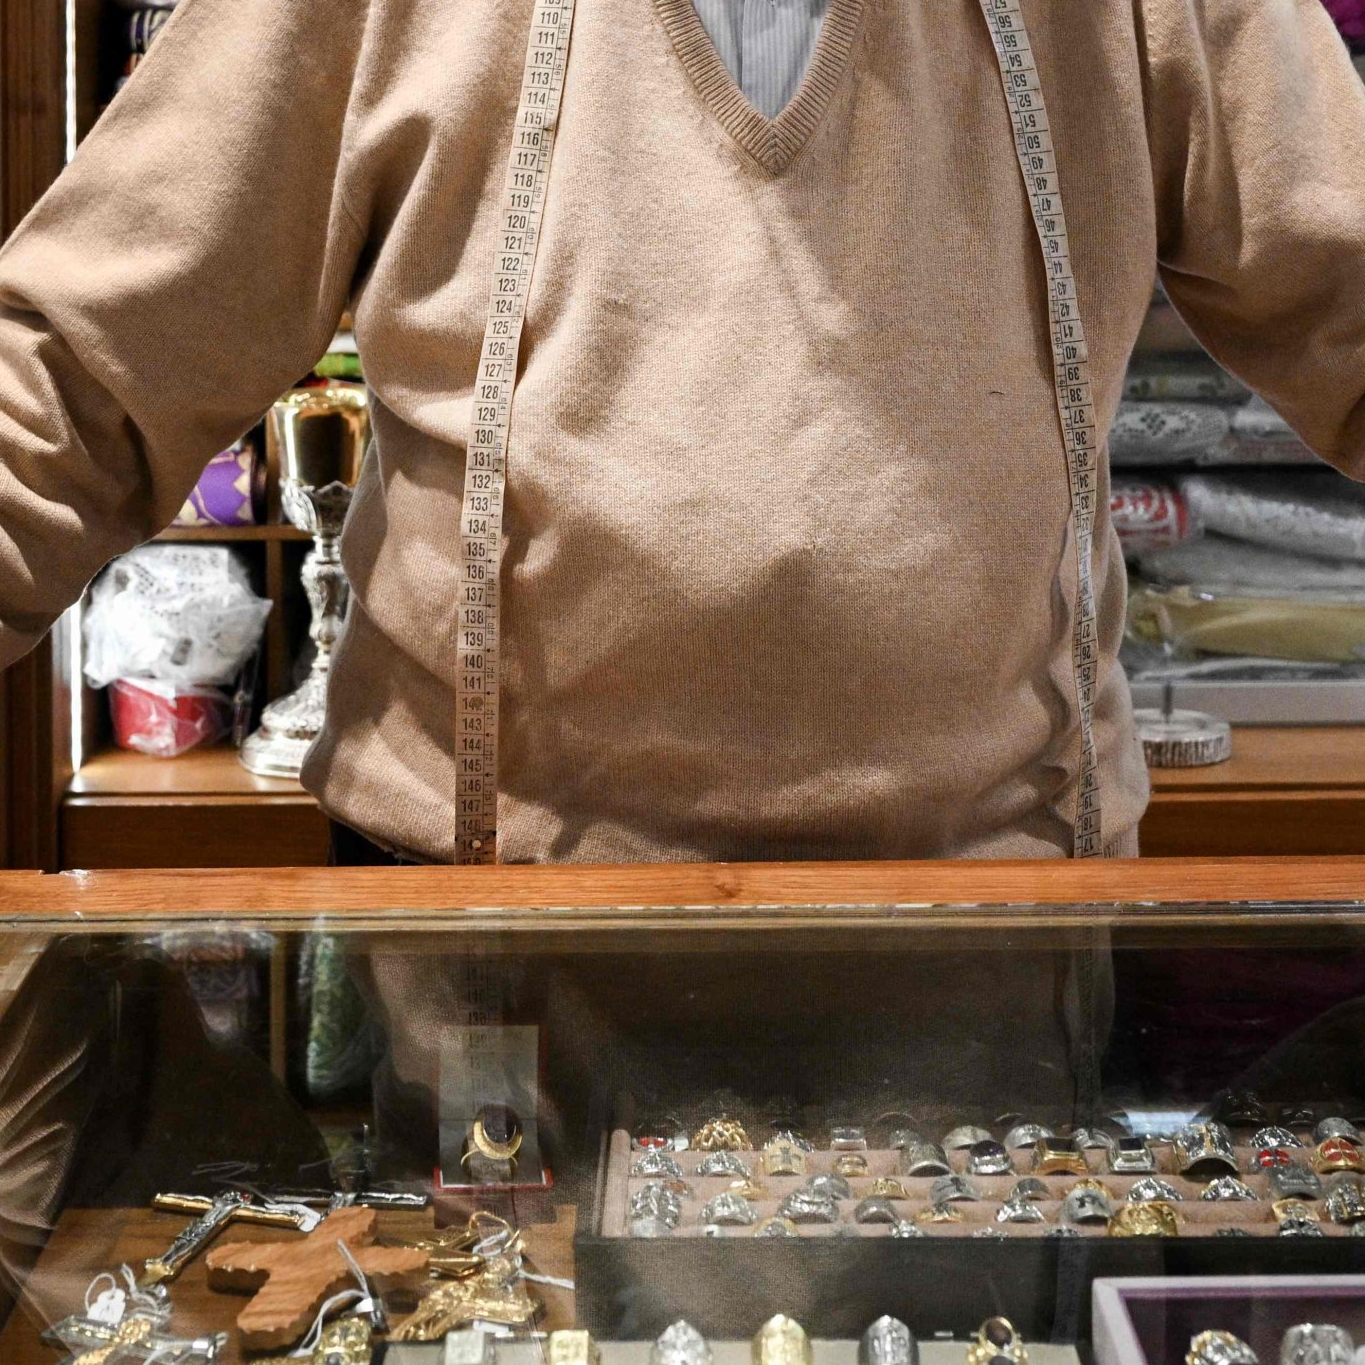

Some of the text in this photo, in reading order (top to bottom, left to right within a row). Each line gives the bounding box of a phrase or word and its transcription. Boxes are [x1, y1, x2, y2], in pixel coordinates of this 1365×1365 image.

[541, 12, 558, 24] 110
[998, 15, 1012, 28] 56
[538, 31, 555, 44] 111
[1004, 35, 1017, 48] 55
[534, 51, 553, 65] 112
[1009, 54, 1022, 67] 54
[555, 64, 561, 76] 56
[531, 72, 549, 84] 113
[1014, 74, 1027, 87] 53
[528, 91, 546, 105] 114
[1019, 94, 1031, 107] 52
[524, 111, 542, 125] 115
[1024, 115, 1035, 127] 51
[521, 132, 539, 146] 116
[1027, 135, 1040, 149] 50
[541, 145, 548, 157] 58
[517, 153, 536, 167] 117
[1031, 157, 1043, 169] 49
[515, 174, 533, 187] 118
[1036, 177, 1047, 190] 48
[511, 194, 529, 208] 119
[1041, 198, 1051, 211] 47
[508, 215, 526, 228] 120
[1045, 219, 1055, 232] 46
[504, 236, 522, 249] 121
[1049, 240, 1059, 253] 45
[501, 257, 519, 271] 122
[1054, 261, 1063, 274] 44
[498, 279, 516, 292] 123
[1057, 282, 1067, 295] 43
[496, 300, 512, 313] 124
[1061, 303, 1070, 316] 42
[493, 321, 509, 334] 125
[1064, 325, 1073, 337] 41
[489, 342, 505, 355] 126
[1066, 346, 1077, 359] 40
[485, 364, 503, 377] 127
[1068, 367, 1080, 380] 39
[481, 385, 499, 399] 128
[1070, 389, 1082, 402] 38
[478, 407, 495, 421] 129
[1074, 410, 1085, 423] 37
[475, 429, 493, 444] 130
[1075, 431, 1087, 444] 36
[474, 452, 491, 466] 131
[1077, 453, 1088, 466] 35
[472, 475, 490, 488] 132
[1079, 474, 1088, 489] 34
[470, 497, 488, 511] 133
[1080, 496, 1089, 509] 33
[468, 519, 486, 533] 134
[467, 542, 486, 556] 135
[466, 564, 484, 579] 136
[466, 587, 484, 601] 137
[465, 610, 484, 624] 138
[464, 631, 483, 646] 139
[463, 654, 483, 669] 140
[463, 676, 481, 689] 141
[463, 697, 482, 710] 14
[463, 718, 482, 731] 143
[462, 738, 482, 751] 144
[462, 759, 482, 772] 145
[462, 779, 481, 792] 146
[462, 800, 481, 812] 147
[1085, 795, 1093, 809] 19
[1084, 818, 1093, 831] 18
[462, 840, 481, 851] 14
[1084, 839, 1094, 852] 17
